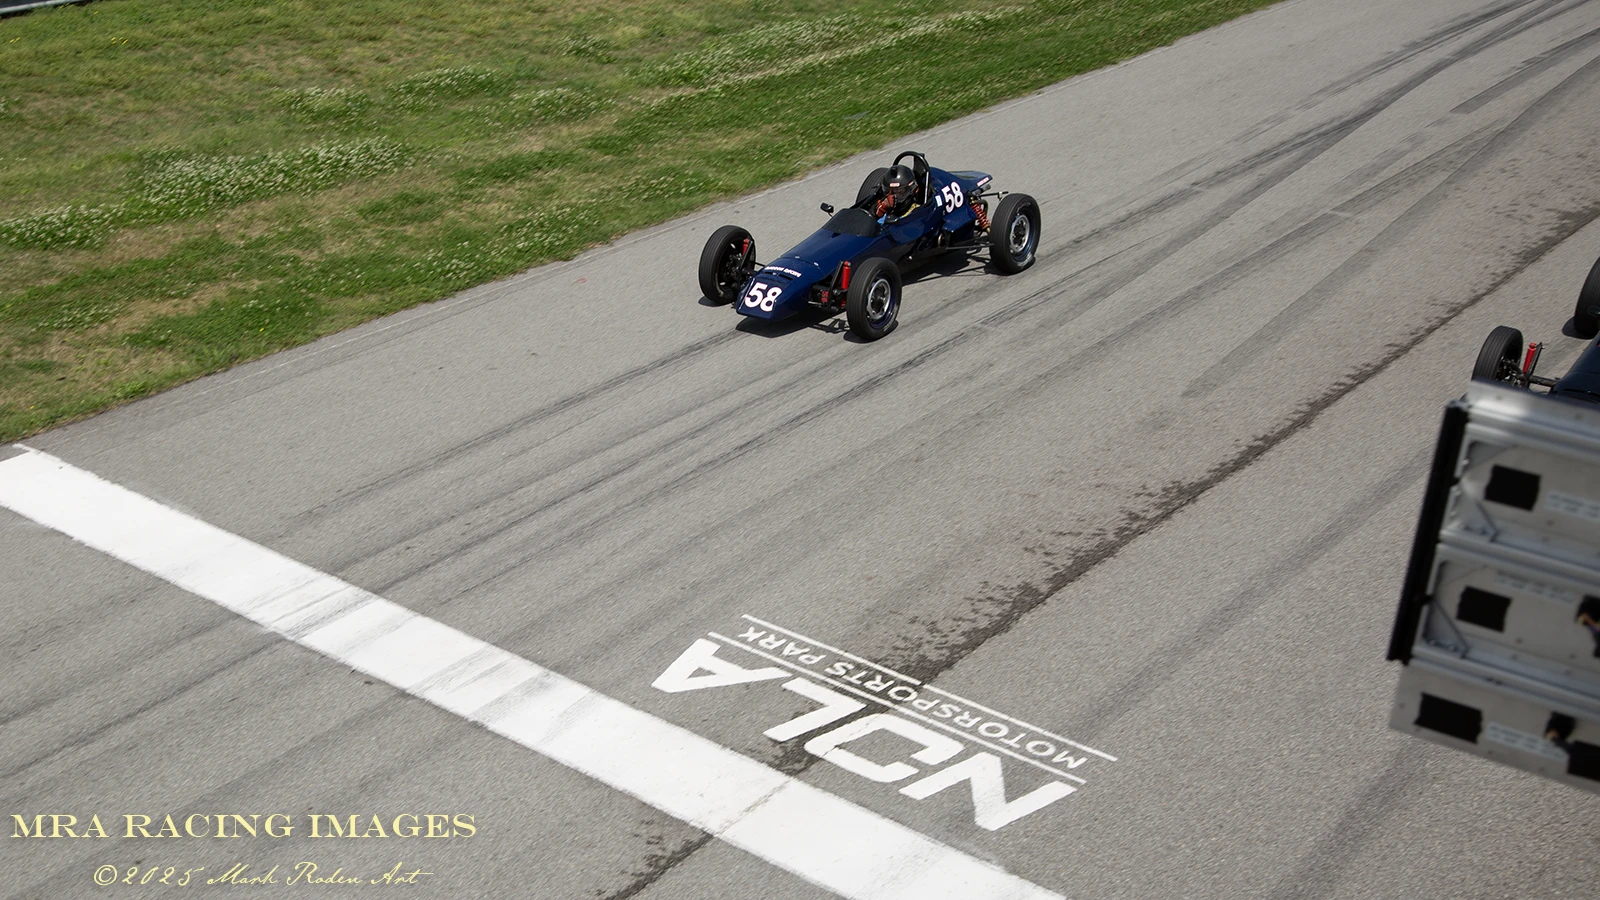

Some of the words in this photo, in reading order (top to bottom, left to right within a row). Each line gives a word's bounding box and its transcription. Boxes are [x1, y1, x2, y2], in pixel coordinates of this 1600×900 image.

[941, 181, 964, 213] 58
[744, 282, 783, 312] 58
[737, 626, 827, 665] PARK
[651, 638, 1078, 832] NOLA
[824, 661, 1088, 770] MOTORSPORTS
